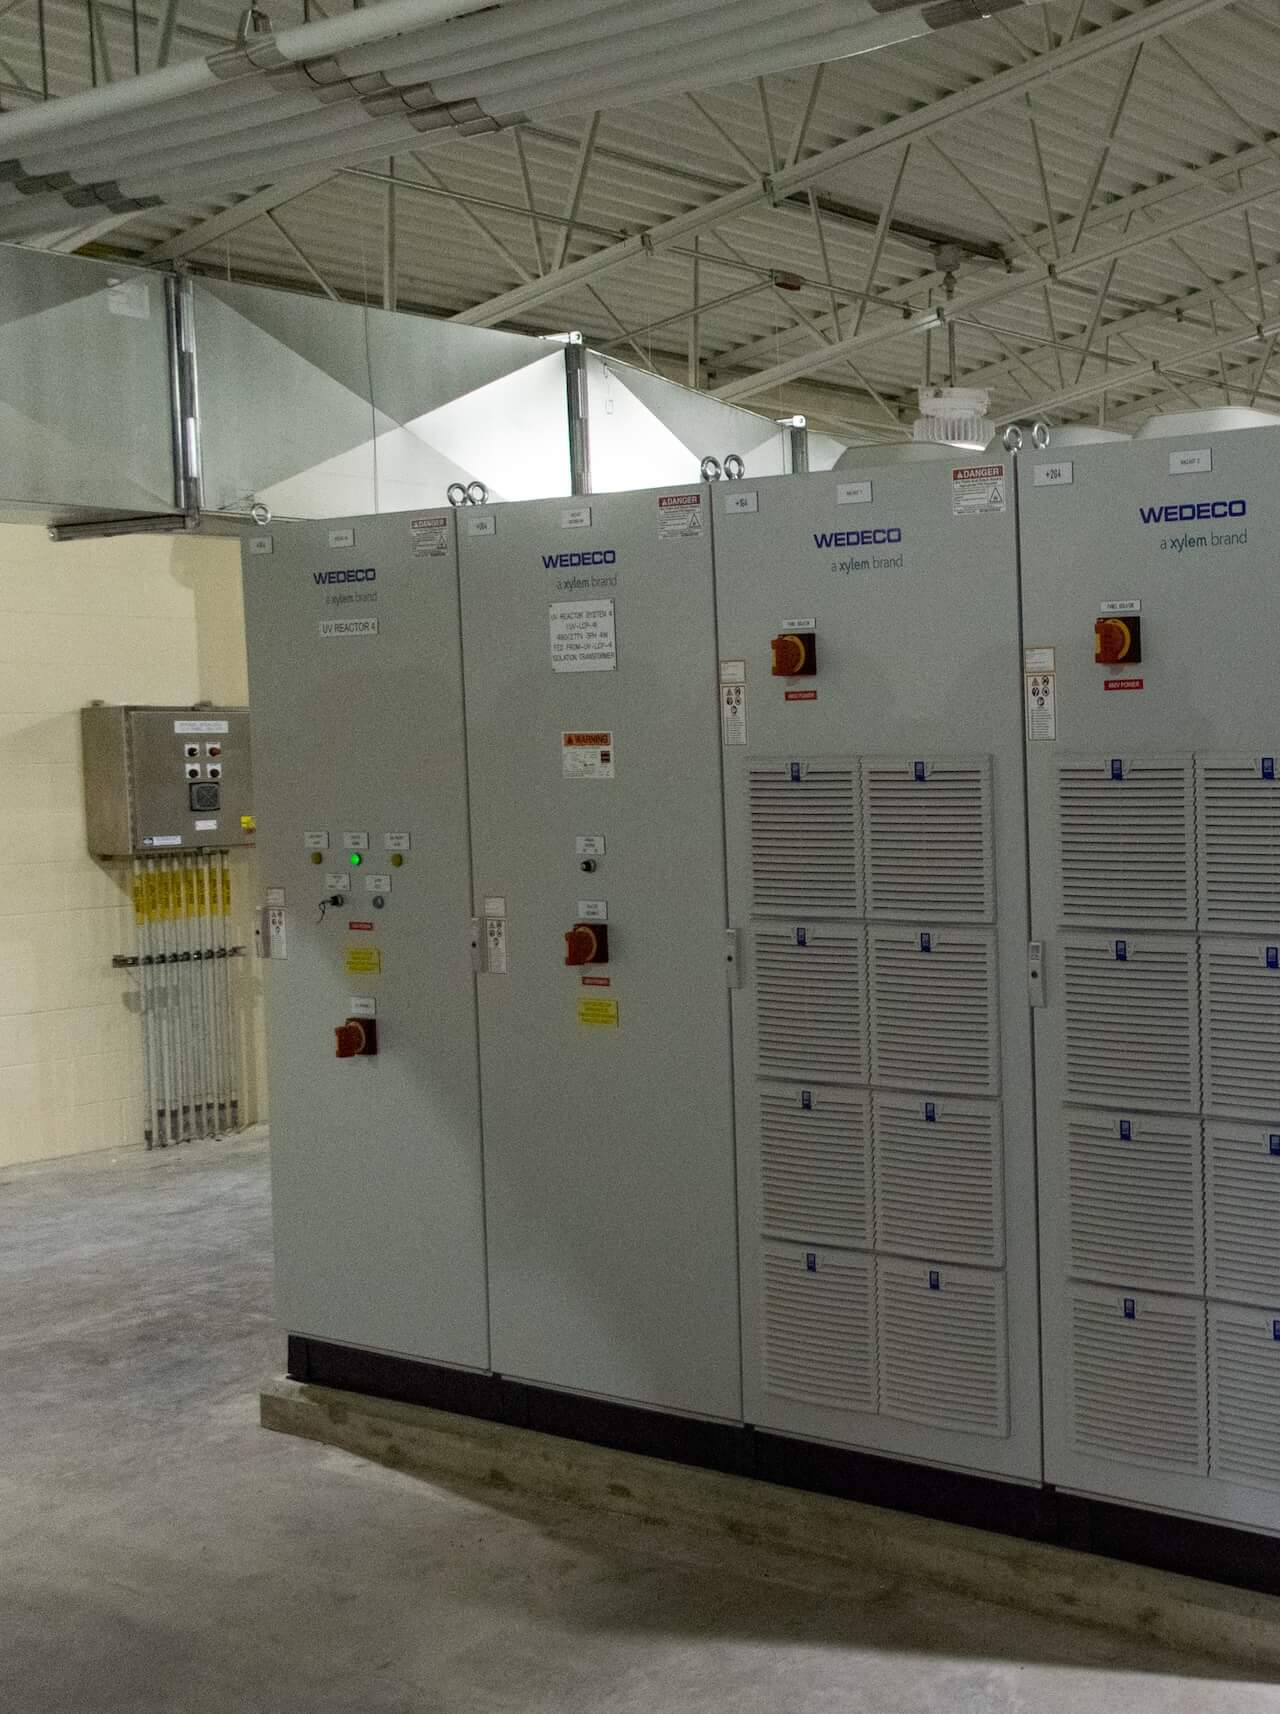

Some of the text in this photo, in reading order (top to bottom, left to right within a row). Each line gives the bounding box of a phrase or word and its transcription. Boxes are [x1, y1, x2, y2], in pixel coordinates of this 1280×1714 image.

[964, 467, 999, 478] DANGER
[669, 495, 698, 505] DANGER
[1139, 500, 1247, 524] WEDECO
[813, 527, 902, 548] WEDECO
[1160, 529, 1247, 553] a xylem brand
[541, 550, 616, 569] WEDECO
[831, 554, 903, 575] a xylem brand
[313, 568, 376, 585] WEDECO
[562, 576, 590, 592] xylem
[591, 575, 617, 587] brand
[322, 623, 332, 634] UV
[334, 622, 369, 633] REACTOR
[575, 734, 609, 744] WARNING
